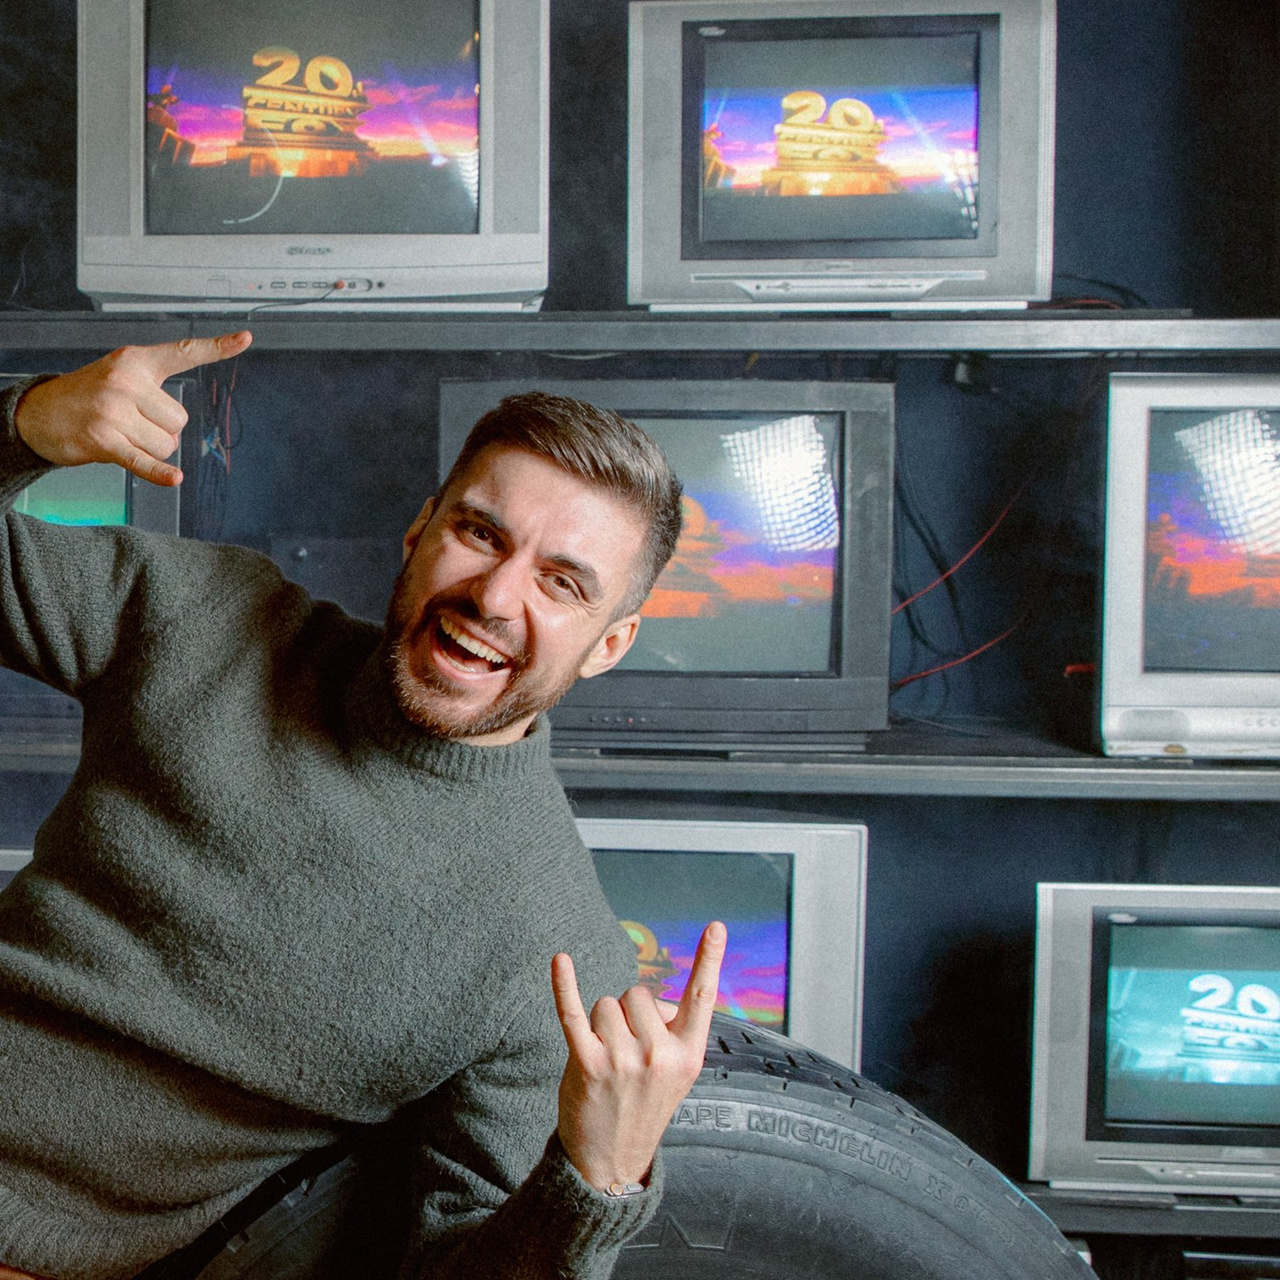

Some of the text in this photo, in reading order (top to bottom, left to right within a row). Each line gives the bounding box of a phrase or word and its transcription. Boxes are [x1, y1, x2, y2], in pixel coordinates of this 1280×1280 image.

[252, 45, 354, 98] 20
[782, 90, 875, 132] 20
[747, 1109, 913, 1182] MICHELIN
